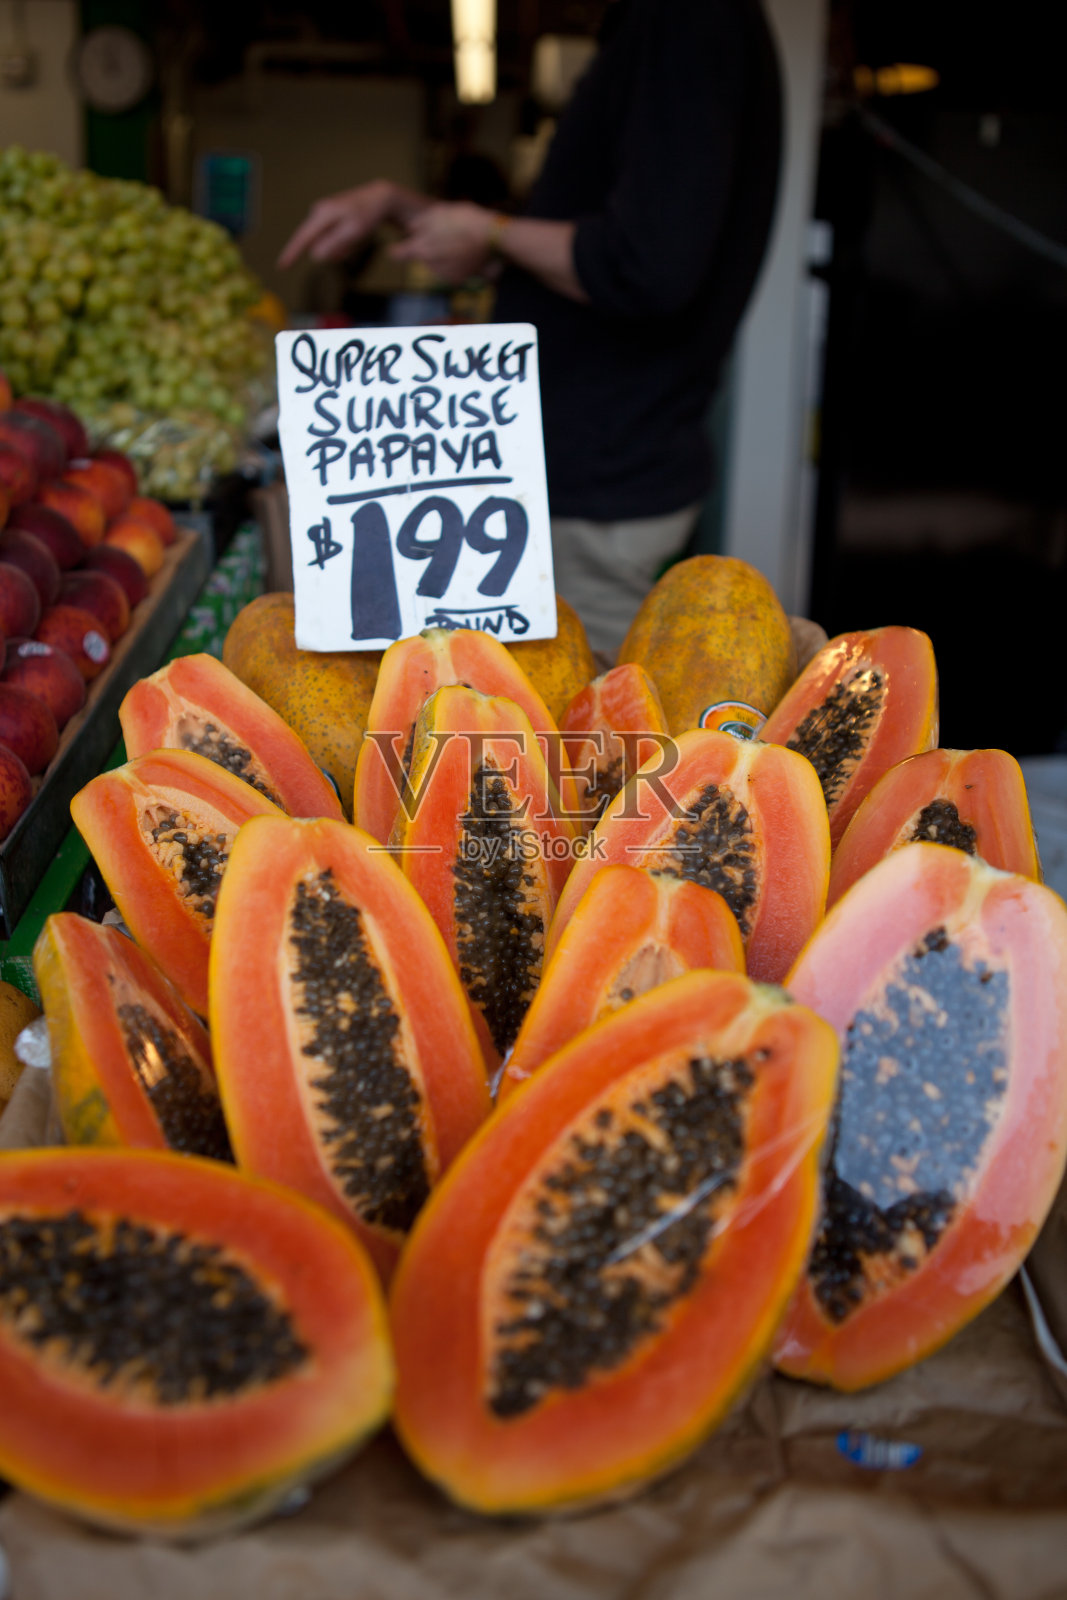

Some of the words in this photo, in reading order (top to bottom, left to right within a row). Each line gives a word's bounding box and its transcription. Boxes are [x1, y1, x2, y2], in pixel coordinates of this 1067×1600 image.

[291, 333, 403, 393] SUPER
[412, 334, 535, 383] SWEET
[307, 385, 518, 437] SUNRISE
[305, 430, 502, 486] PAPAYA
